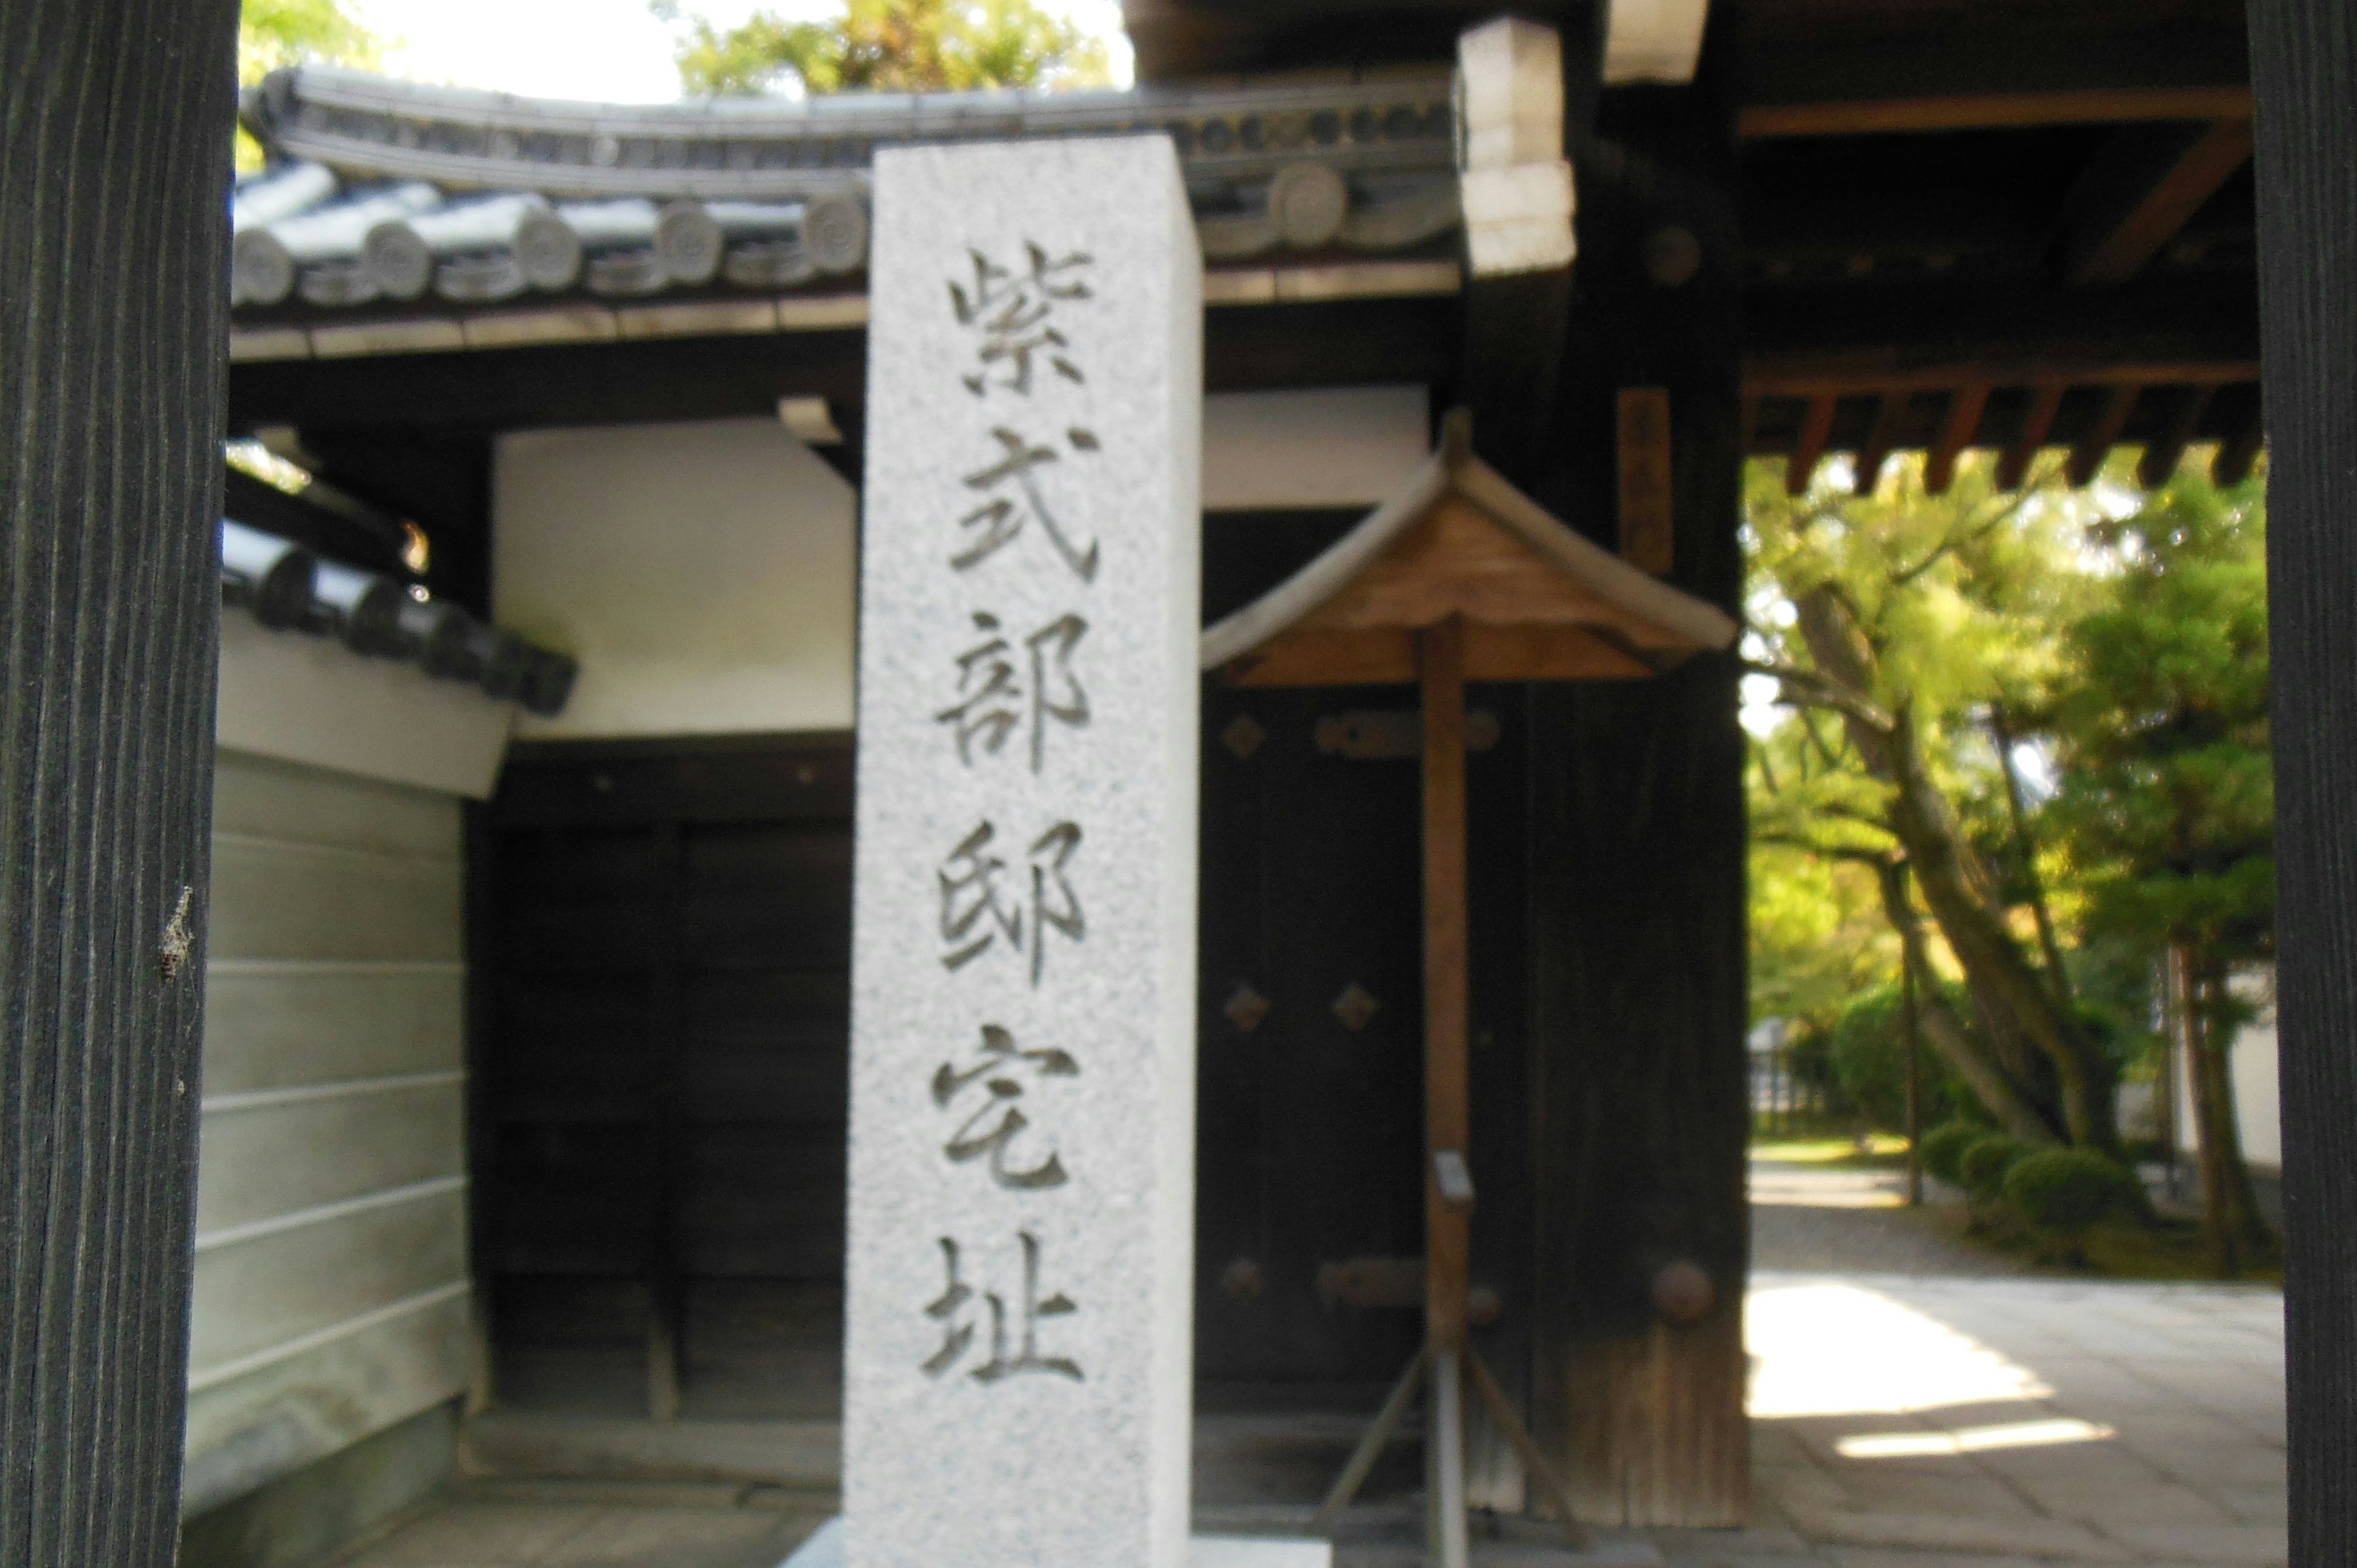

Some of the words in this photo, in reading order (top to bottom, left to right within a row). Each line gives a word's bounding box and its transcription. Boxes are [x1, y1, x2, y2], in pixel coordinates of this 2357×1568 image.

[921, 239, 1099, 1385] 紫式部邸宅址
